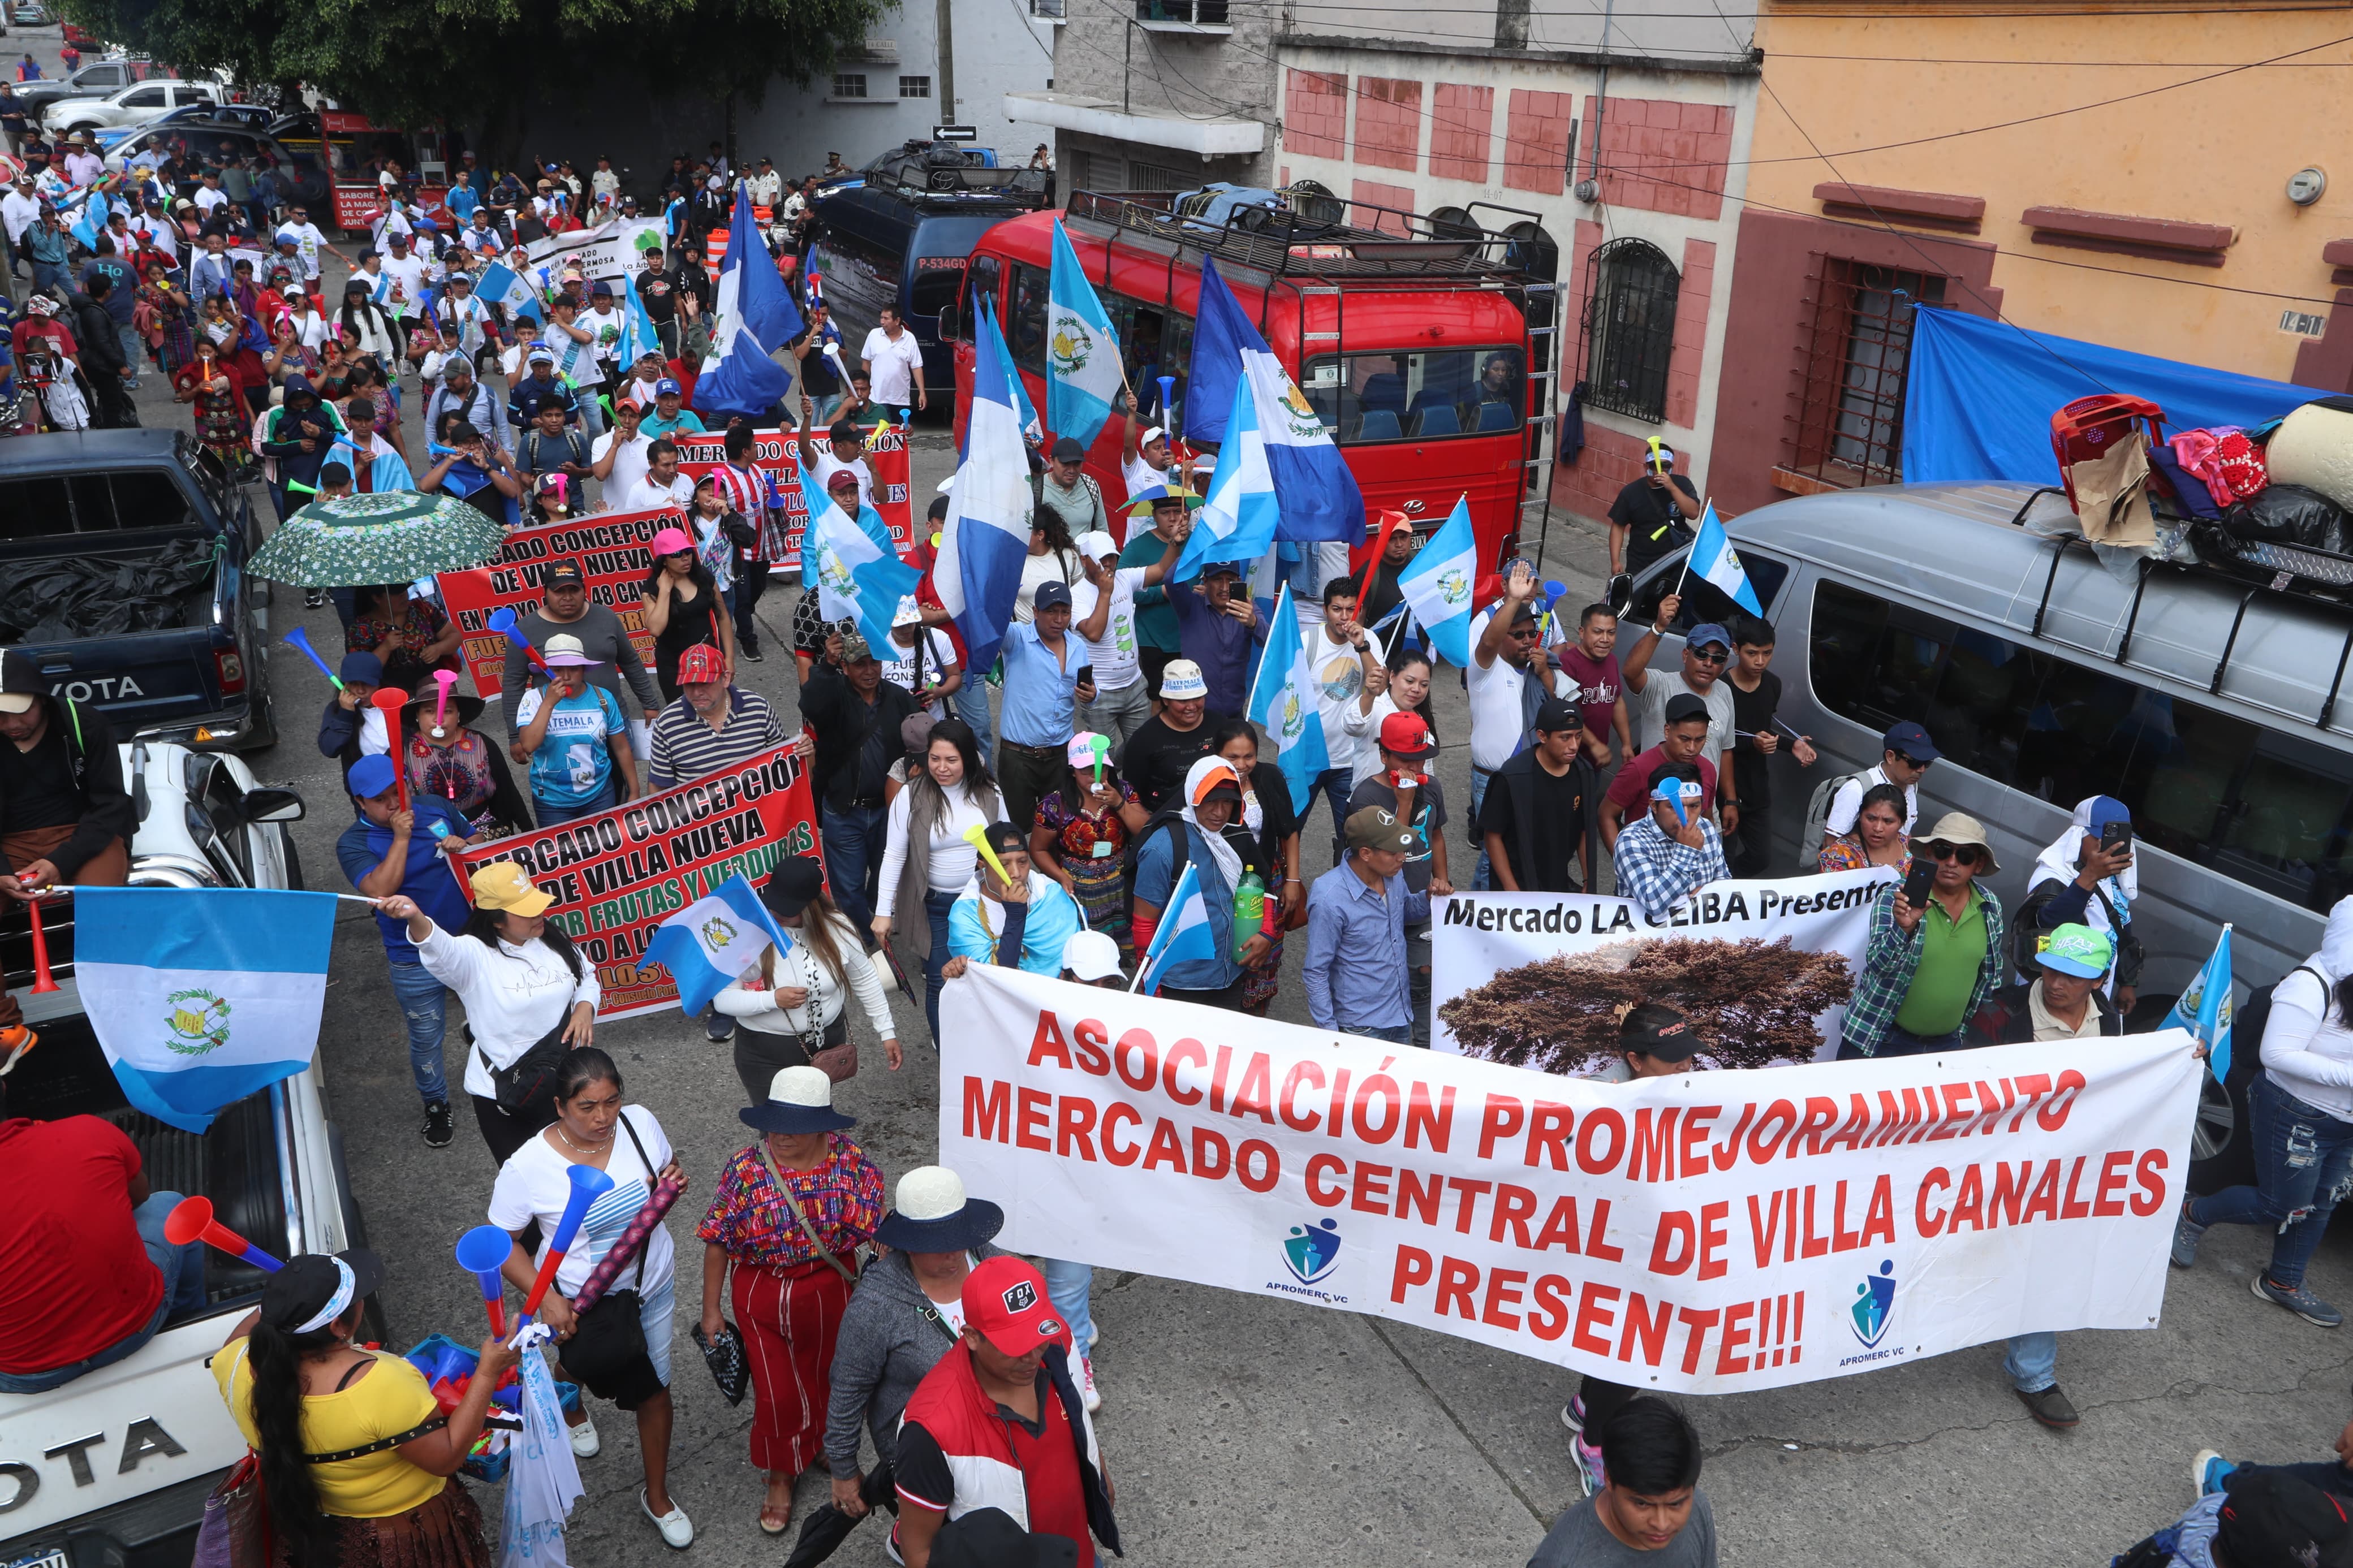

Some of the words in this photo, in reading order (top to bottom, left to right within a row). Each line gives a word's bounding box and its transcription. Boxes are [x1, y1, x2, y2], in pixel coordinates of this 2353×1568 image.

[582, 256, 615, 268] ERMOSA
[919, 258, 966, 269] P-534GD
[2281, 311, 2326, 337] 14-11
[1411, 536, 1427, 550] BVX
[489, 568, 522, 595] DE
[579, 547, 656, 577] NUEVA
[457, 608, 483, 633] EN
[591, 582, 614, 607] 48
[464, 635, 507, 662] FUE
[893, 657, 932, 670] FUEA
[547, 716, 594, 728] ATEMALA
[624, 751, 801, 842] CONCEPCIÓN
[539, 872, 584, 908] DE
[581, 843, 670, 897] VILLA
[669, 807, 766, 869] NUEVA
[548, 909, 587, 938] OR
[588, 878, 684, 932] FRUTAS
[682, 869, 699, 903] Y
[1444, 899, 1582, 934] Mercado
[1592, 902, 1635, 934] LA
[1760, 879, 1894, 919] Presente
[611, 932, 632, 961] A
[2053, 935, 2097, 951] HEAT
[599, 961, 661, 990] LOS
[611, 987, 657, 1007] Consuelo
[657, 983, 679, 997] Porr
[1027, 1010, 1457, 1154] ASOCIACIÓN
[1477, 1069, 2087, 1183] PROMEJORAMIENTO
[962, 1075, 1281, 1193] MERCADO
[1304, 1153, 1624, 1263] CENTRAL
[1648, 1200, 1729, 1281] DE
[1748, 1174, 1895, 1268] VILLA
[1915, 1148, 2169, 1239] CANALES
[1007, 1284, 1031, 1303] FOX
[1266, 1282, 1329, 1299] APROMERC
[1333, 1294, 1348, 1303] VC
[1391, 1243, 1804, 1376] PRESENTE!!!
[1839, 1350, 1890, 1367] APROMERC
[1892, 1346, 1904, 1356] VC
[525, 1372, 536, 1389] SOY
[532, 1389, 544, 1409] PURO
[0, 1415, 187, 1514] OTA
